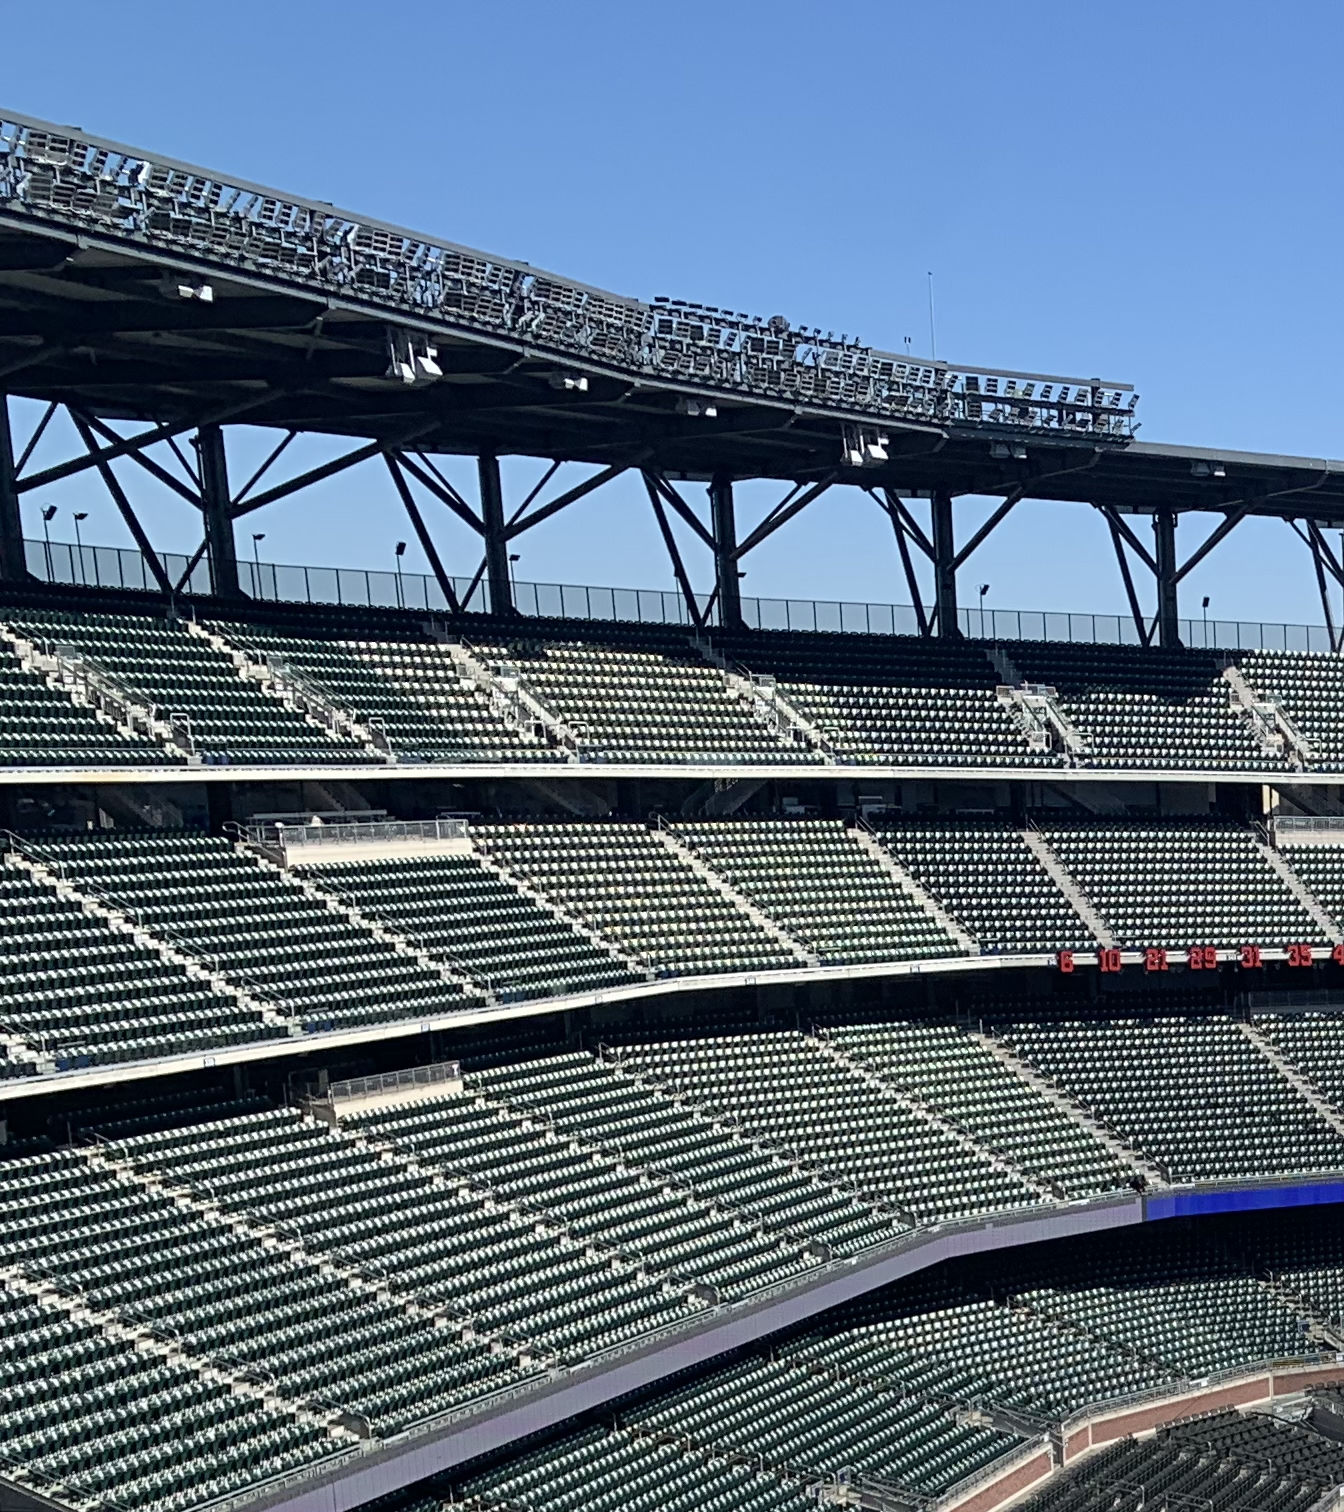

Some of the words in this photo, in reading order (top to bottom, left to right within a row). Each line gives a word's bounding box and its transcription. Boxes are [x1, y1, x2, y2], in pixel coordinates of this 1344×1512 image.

[1058, 951, 1074, 972] 6
[1100, 949, 1121, 971] 10
[1146, 949, 1168, 971] 21
[1191, 947, 1216, 970] 29
[1242, 945, 1262, 967] 31
[1288, 944, 1312, 967] 35
